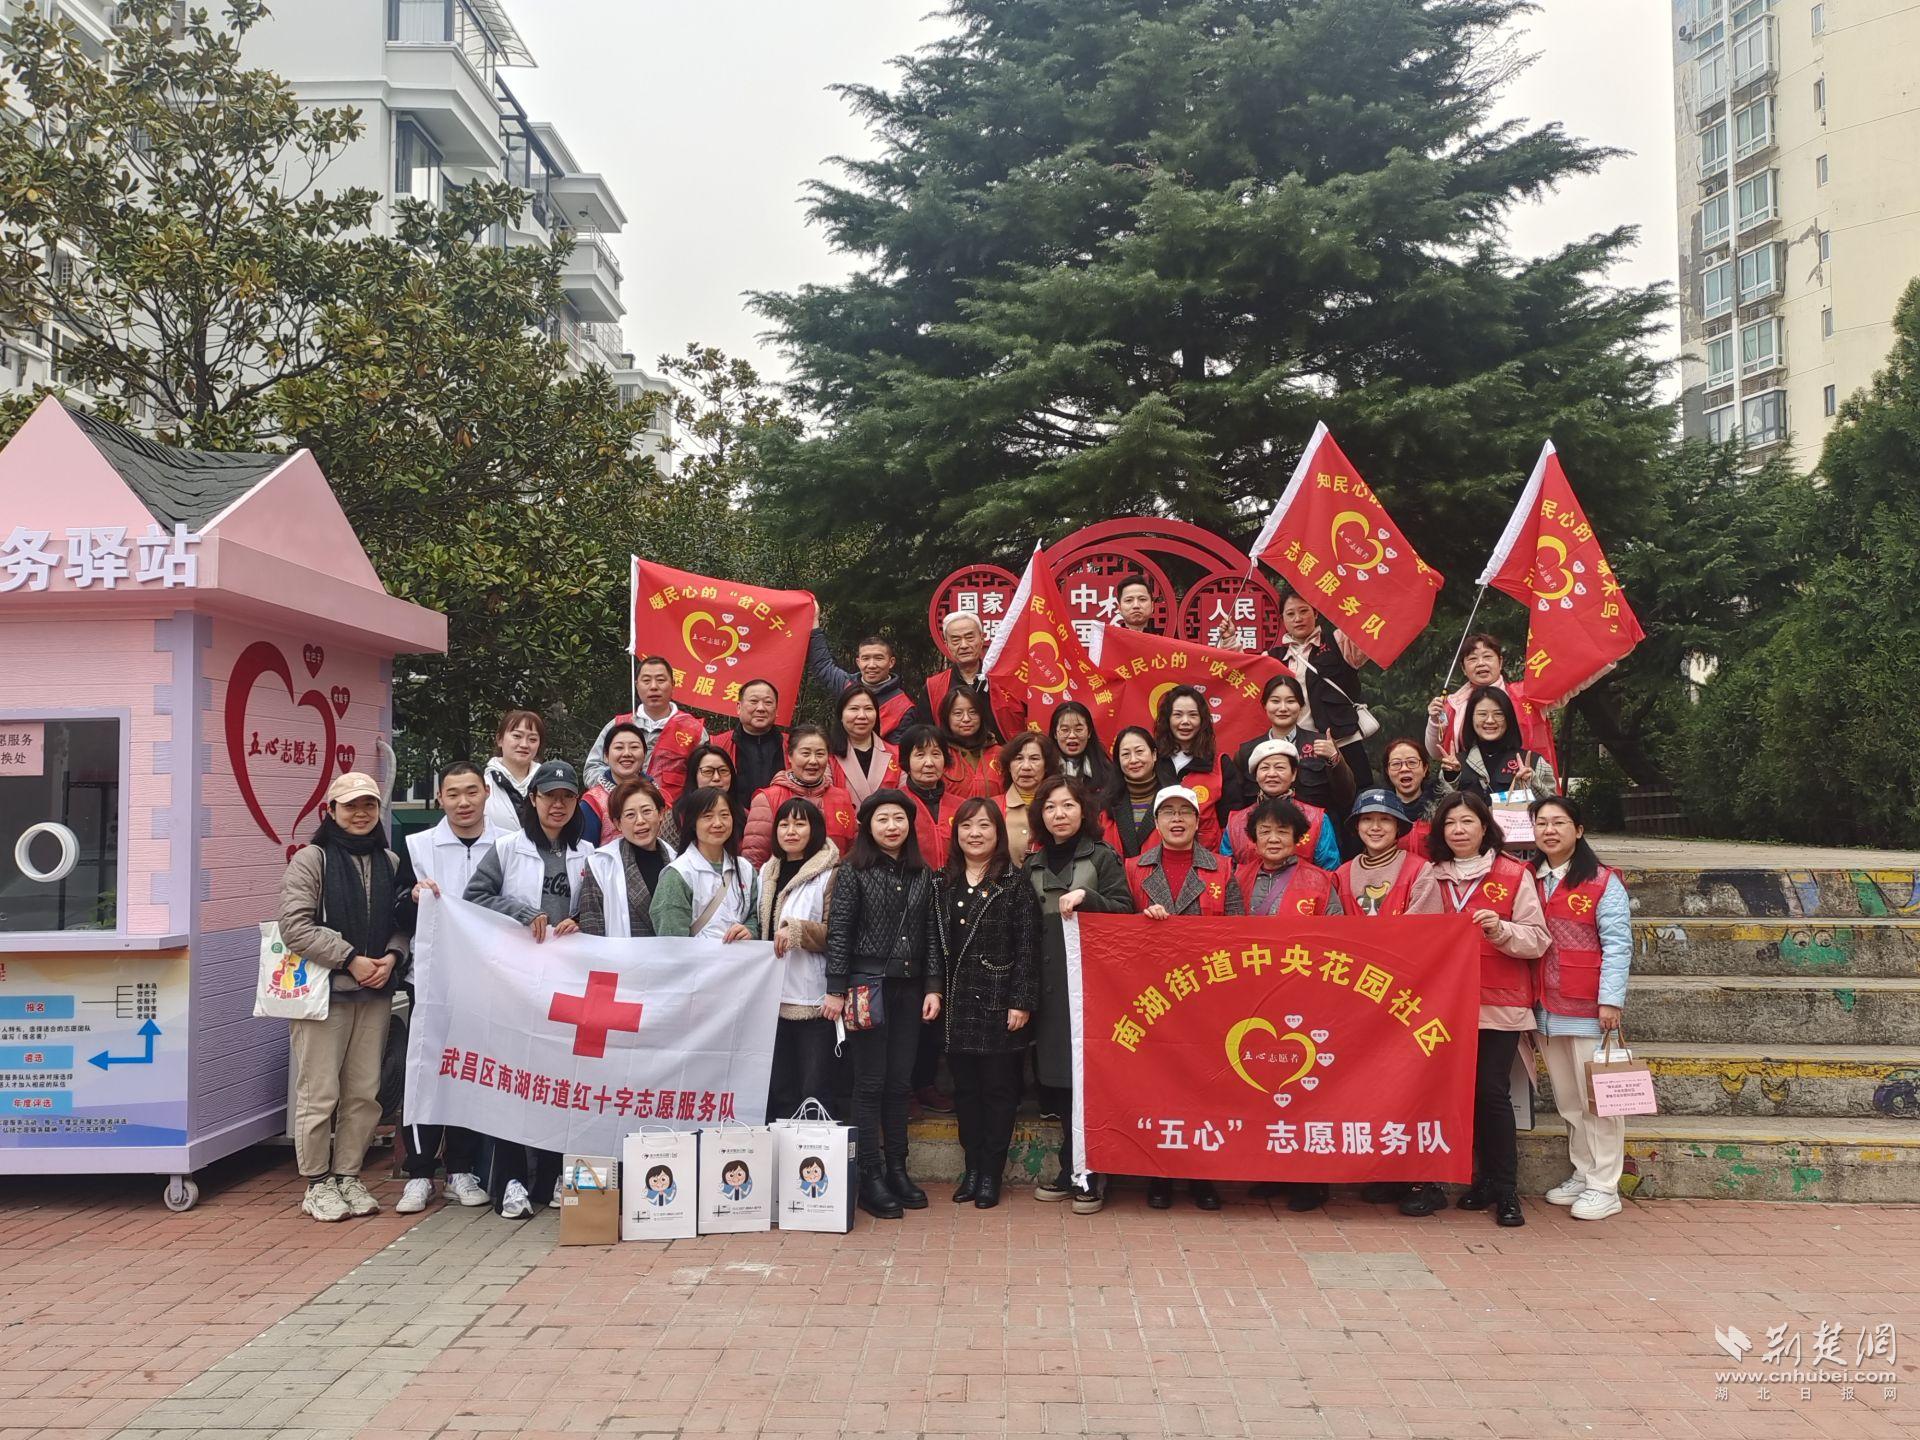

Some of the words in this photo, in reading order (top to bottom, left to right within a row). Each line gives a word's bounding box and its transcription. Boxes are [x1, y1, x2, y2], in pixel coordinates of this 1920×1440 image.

[0, 523, 201, 592] 务驿站
[1284, 541, 1386, 640] 志愿服务队
[958, 592, 1003, 615] 国家
[1209, 598, 1256, 620] 人民
[248, 731, 318, 767] 五心志愿者
[1111, 943, 1452, 1057] 南湖街道中央花园社区
[439, 1047, 736, 1122] 武昌区南湖街道红十字志愿服务队
